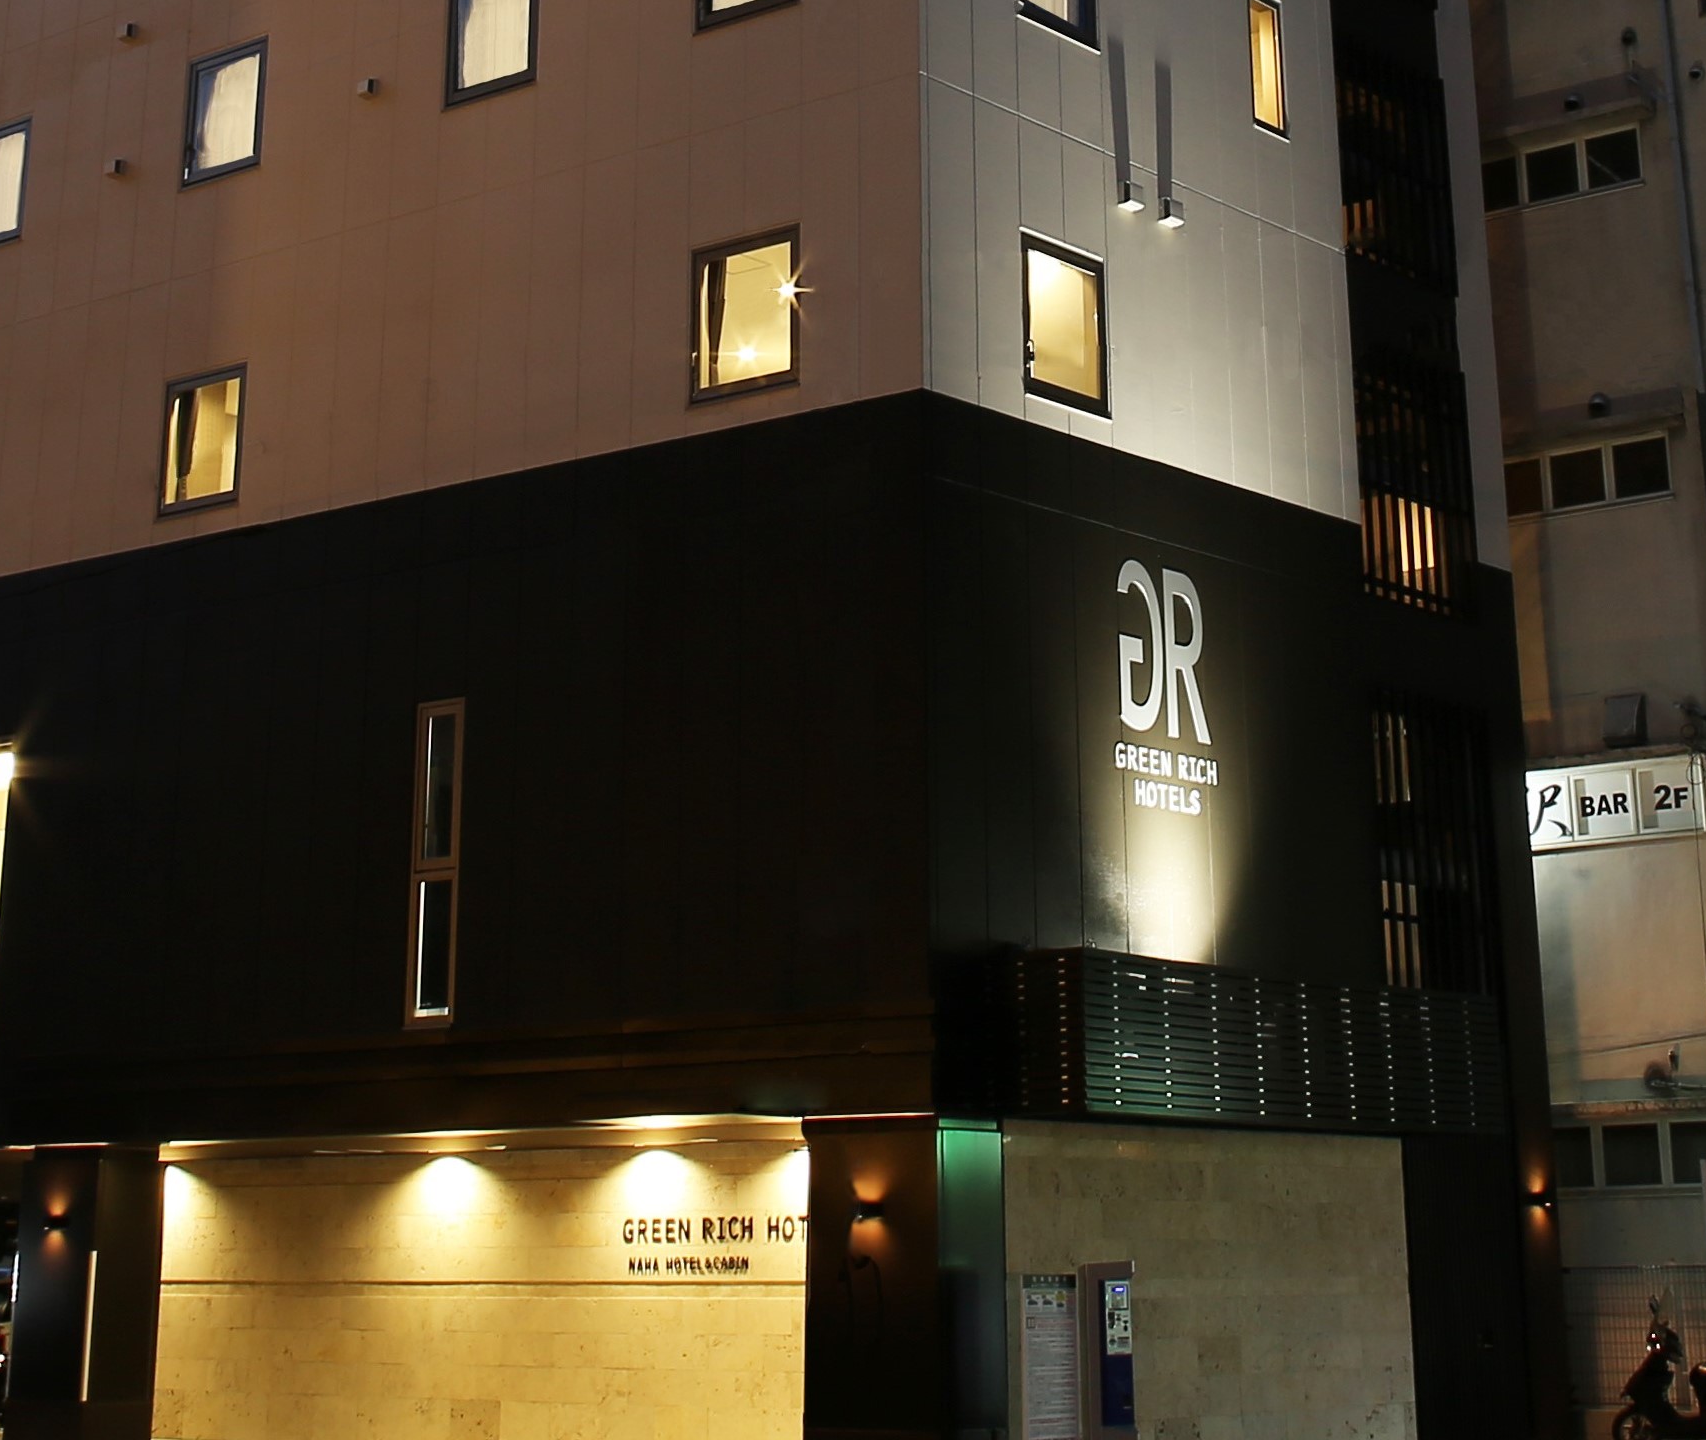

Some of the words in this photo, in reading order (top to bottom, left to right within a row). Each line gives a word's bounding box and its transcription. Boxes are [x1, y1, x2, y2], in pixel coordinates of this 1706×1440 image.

[1114, 742, 1173, 778] GREEN
[1177, 753, 1219, 786] RICH
[1133, 778, 1202, 816] HOTELS
[1579, 791, 1630, 818] BAR
[1653, 784, 1689, 811] 2F
[622, 1217, 691, 1245] GREEN
[702, 1216, 754, 1244] RICH
[628, 1256, 660, 1275] NAHA
